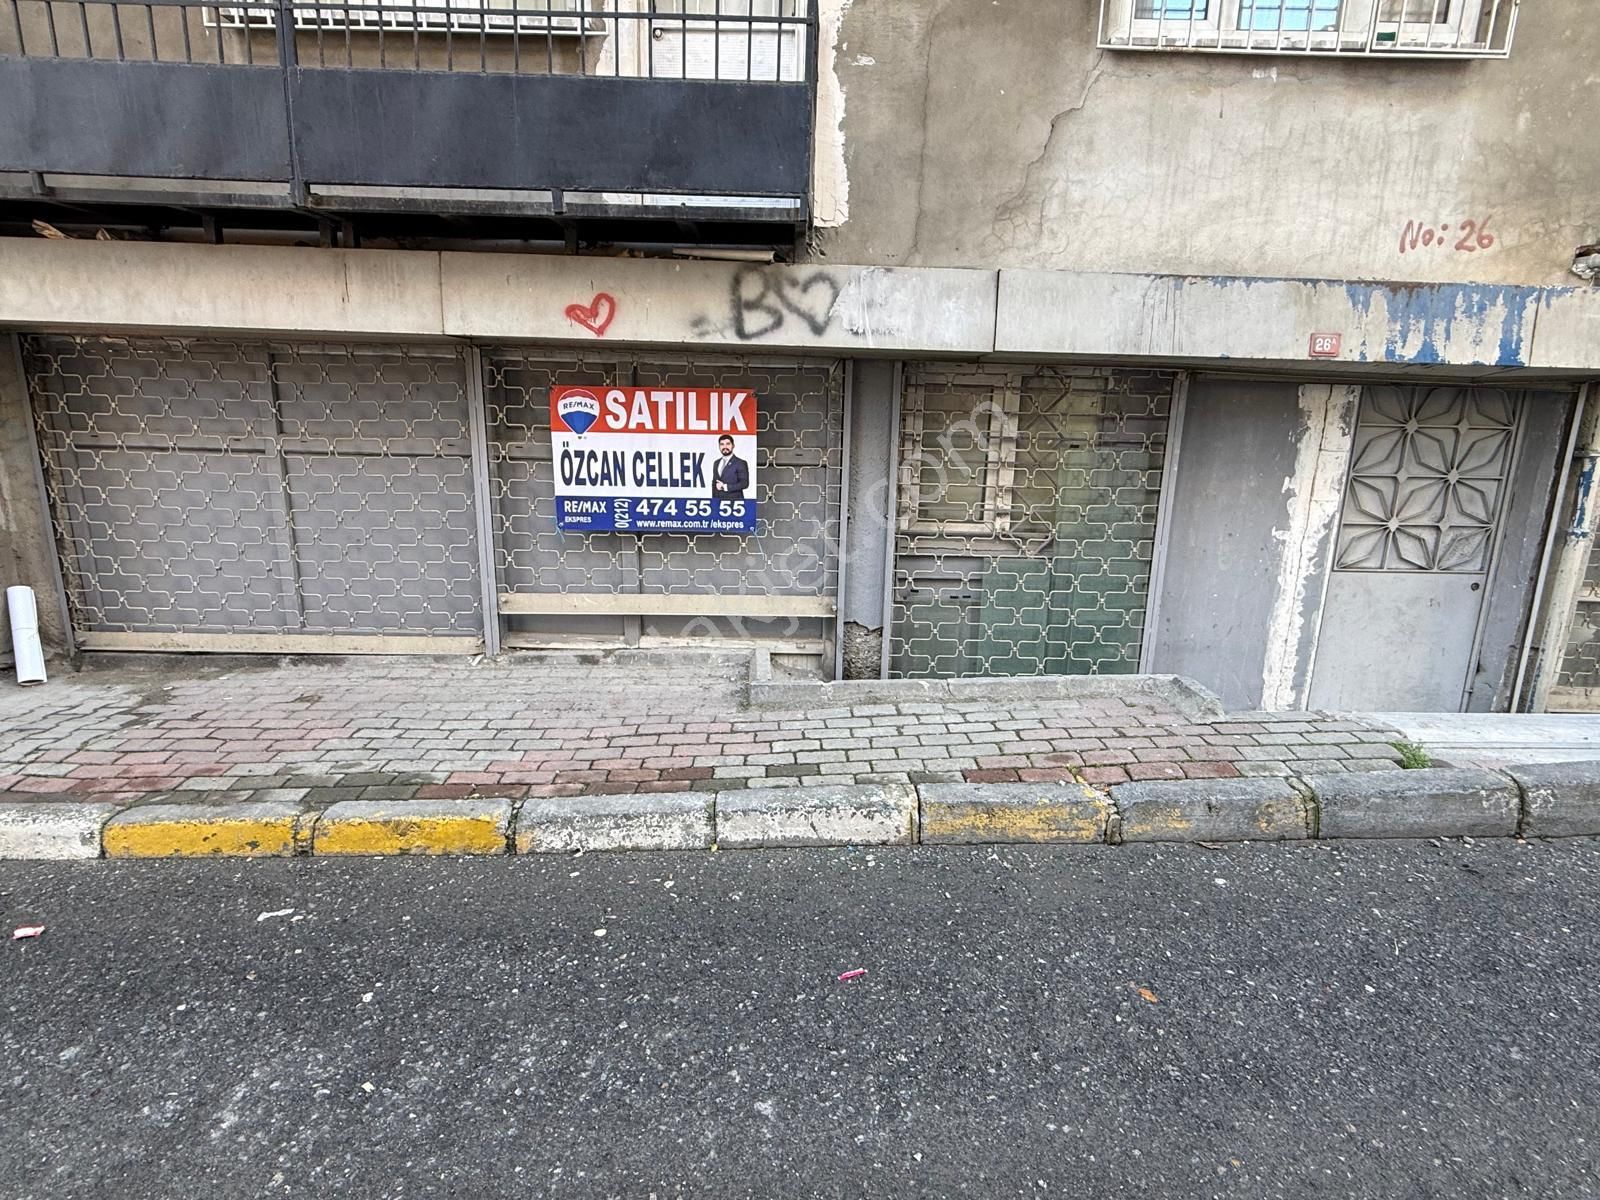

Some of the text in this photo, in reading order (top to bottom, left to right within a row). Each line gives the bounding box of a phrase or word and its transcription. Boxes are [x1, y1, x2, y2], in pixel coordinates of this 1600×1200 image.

[1399, 214, 1495, 253] No: 26
[563, 401, 596, 411] RE/MAX
[605, 389, 748, 431] SATILIK
[560, 440, 706, 489] ÖZCAN CELLEK
[564, 500, 607, 514] RE/MAX
[564, 515, 592, 523] EKSPRES
[614, 498, 632, 528] 0(212)
[635, 499, 746, 517] 474 55 55
